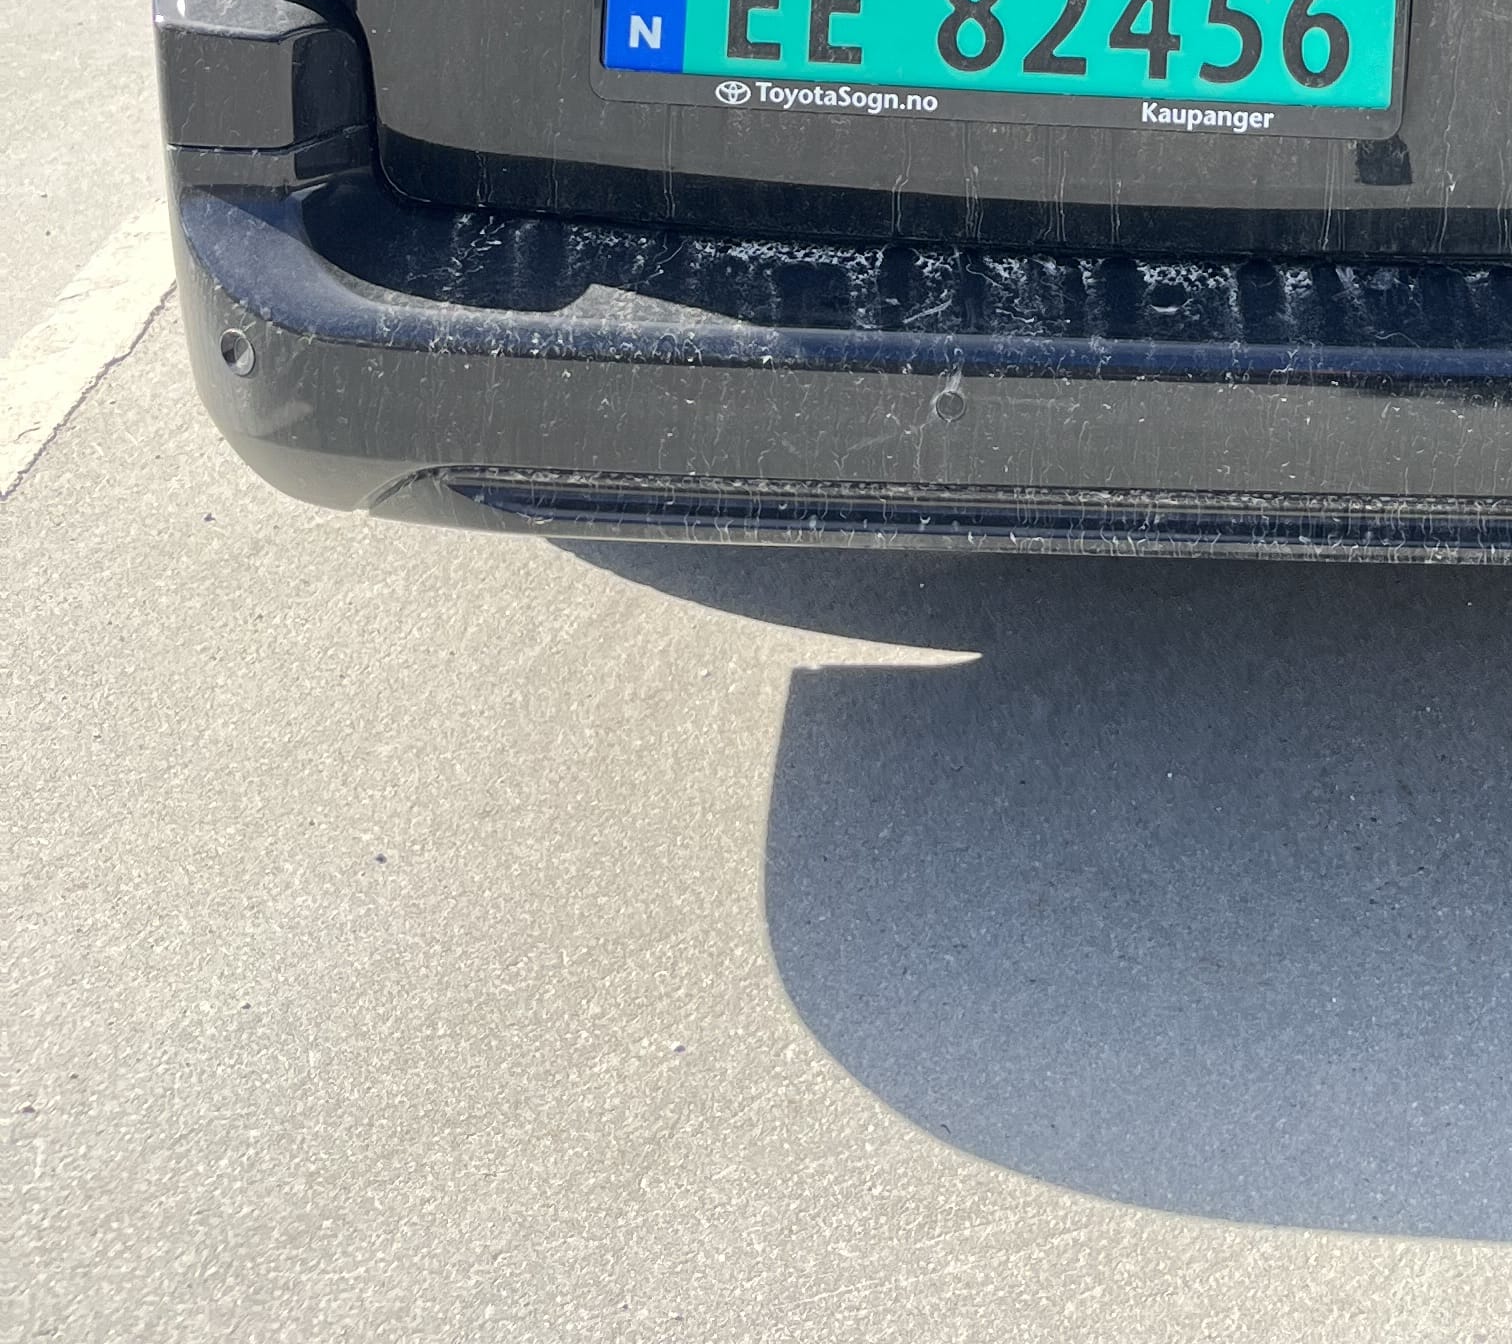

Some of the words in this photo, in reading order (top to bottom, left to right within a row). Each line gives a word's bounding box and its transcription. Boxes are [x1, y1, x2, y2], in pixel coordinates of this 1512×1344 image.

[628, 15, 663, 49] N
[754, 81, 939, 114] ToyotaSogn.no
[1140, 101, 1276, 134] Kaupanger
